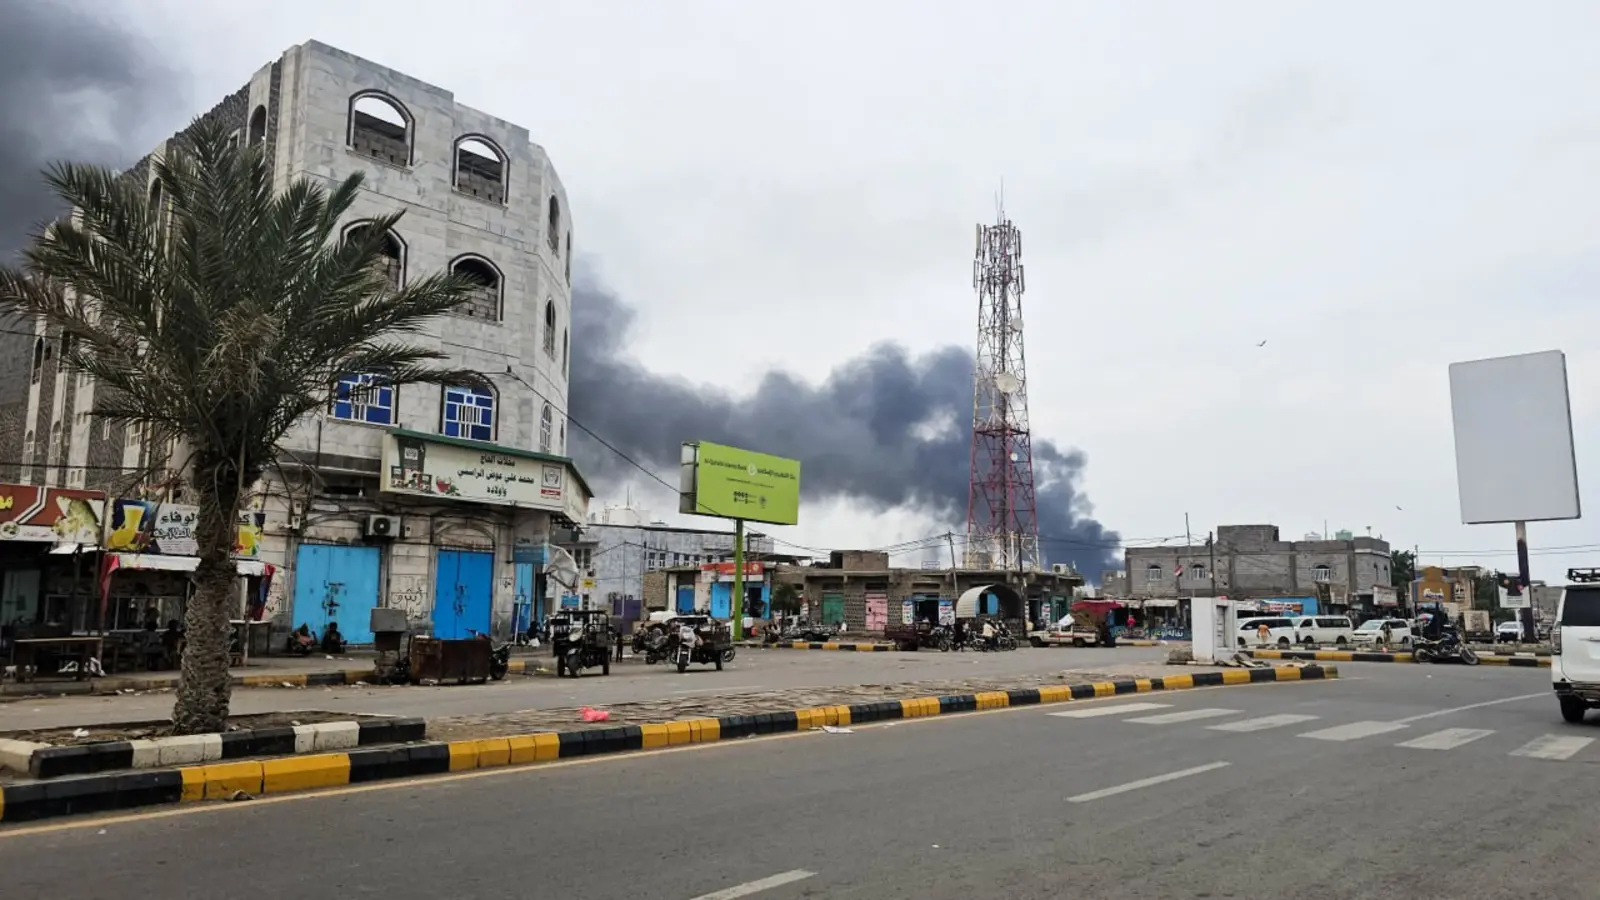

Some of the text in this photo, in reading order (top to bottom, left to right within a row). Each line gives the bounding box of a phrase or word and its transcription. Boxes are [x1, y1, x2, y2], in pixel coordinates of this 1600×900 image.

[504, 472, 517, 483] علي
[518, 475, 534, 484] محمد
[160, 510, 196, 526] لوفاء
